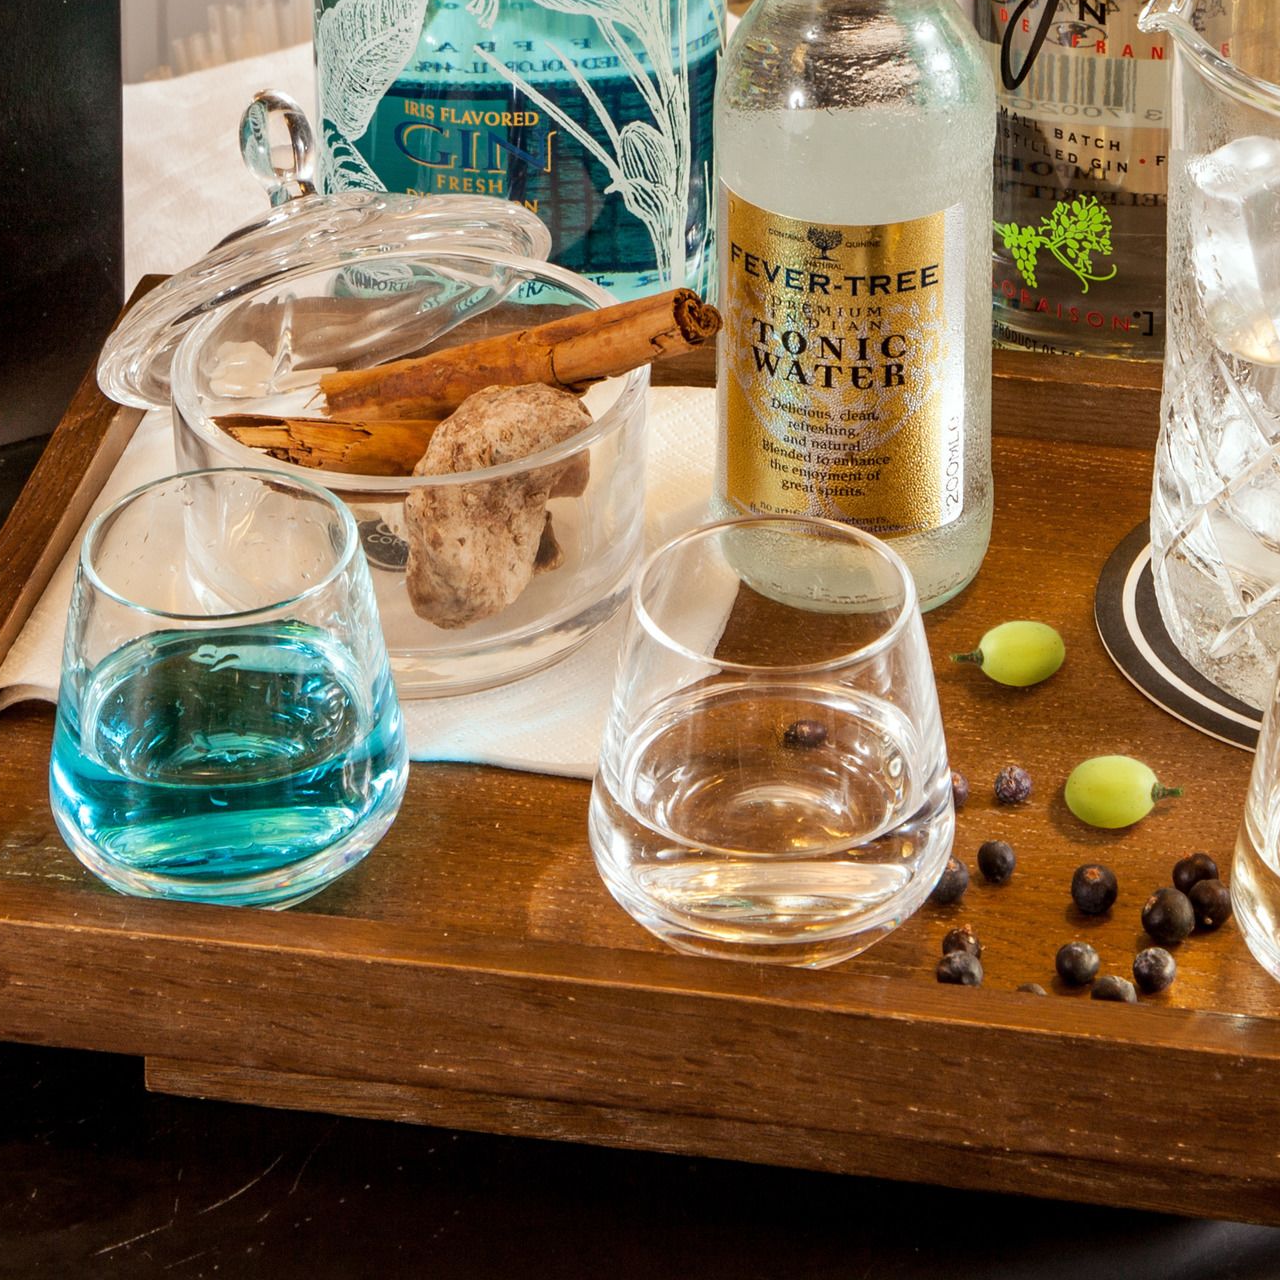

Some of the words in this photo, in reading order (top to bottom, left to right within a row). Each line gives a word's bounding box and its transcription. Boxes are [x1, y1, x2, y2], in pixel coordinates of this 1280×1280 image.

[999, 7, 1030, 33] DE
[1070, 33, 1231, 62] FRANE
[404, 99, 435, 120] IRIS
[440, 106, 540, 127] FLAVORED
[1000, 104, 1042, 133] MALL
[1054, 126, 1121, 152] BATCH
[394, 120, 557, 173] GIN
[1004, 127, 1078, 164] STILLED
[1091, 158, 1129, 174] GIN
[436, 173, 503, 194] FRESH
[730, 241, 940, 297] FEVER-TREE
[770, 295, 882, 317] PREMIUM
[993, 277, 1131, 333] ORAISON
[770, 310, 882, 331] INDIAN
[751, 317, 906, 361] TONIC
[993, 320, 1038, 352] PRODUCT
[751, 344, 906, 390] WATER
[770, 397, 835, 421] Delicious,
[783, 432, 808, 447] and
[787, 420, 860, 438] refreshing,
[762, 438, 812, 464] Blended
[815, 453, 830, 466] to
[833, 453, 891, 467] enhance
[770, 458, 789, 472] the
[792, 464, 863, 486] enjoyment
[866, 470, 881, 482] of
[781, 478, 814, 494] great
[818, 483, 866, 498] spirits.
